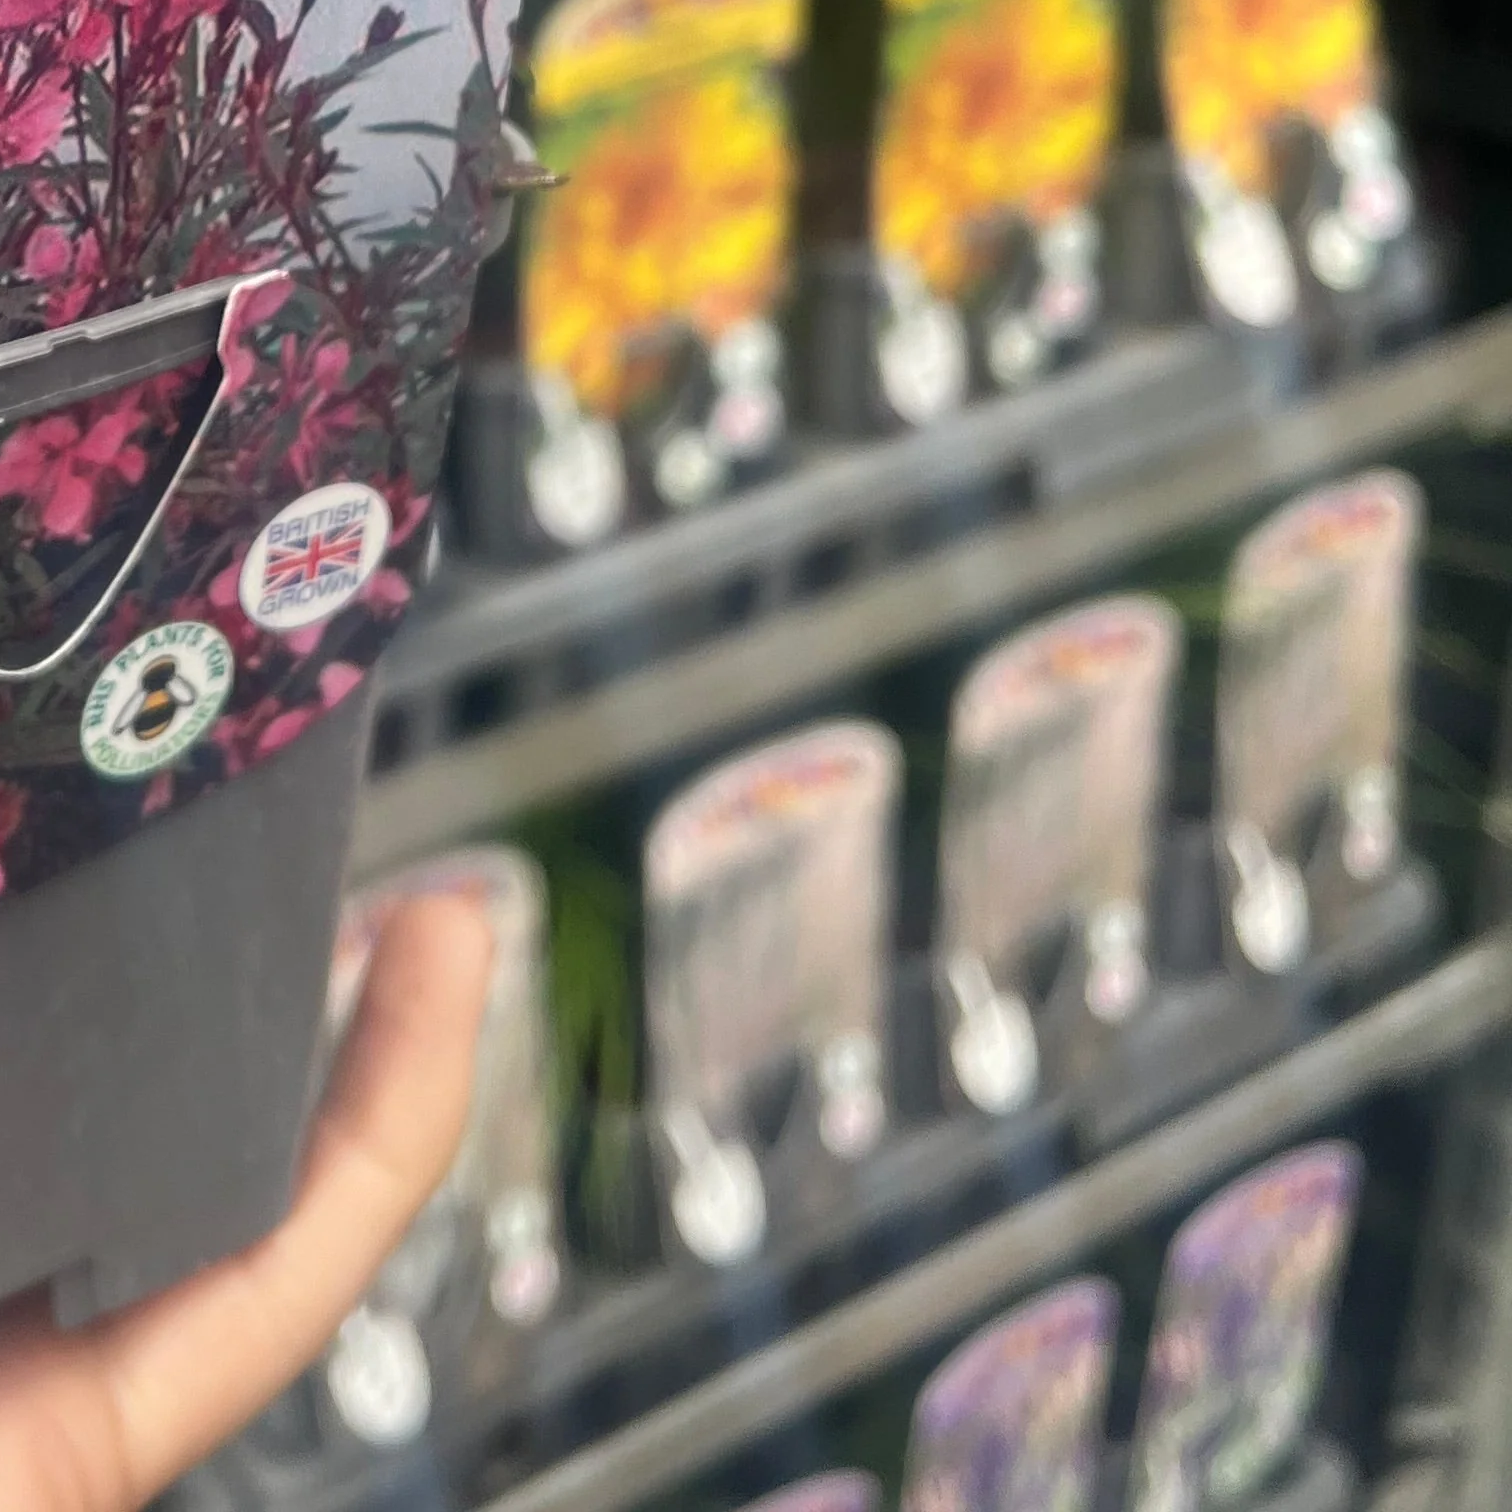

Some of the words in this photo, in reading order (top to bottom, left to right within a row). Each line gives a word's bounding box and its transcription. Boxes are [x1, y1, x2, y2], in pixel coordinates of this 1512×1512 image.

[269, 498, 371, 541] BRITISH
[257, 573, 358, 617] GROWN
[85, 679, 116, 727] RHS
[115, 624, 207, 672] PLANTS
[202, 638, 225, 683] FOR
